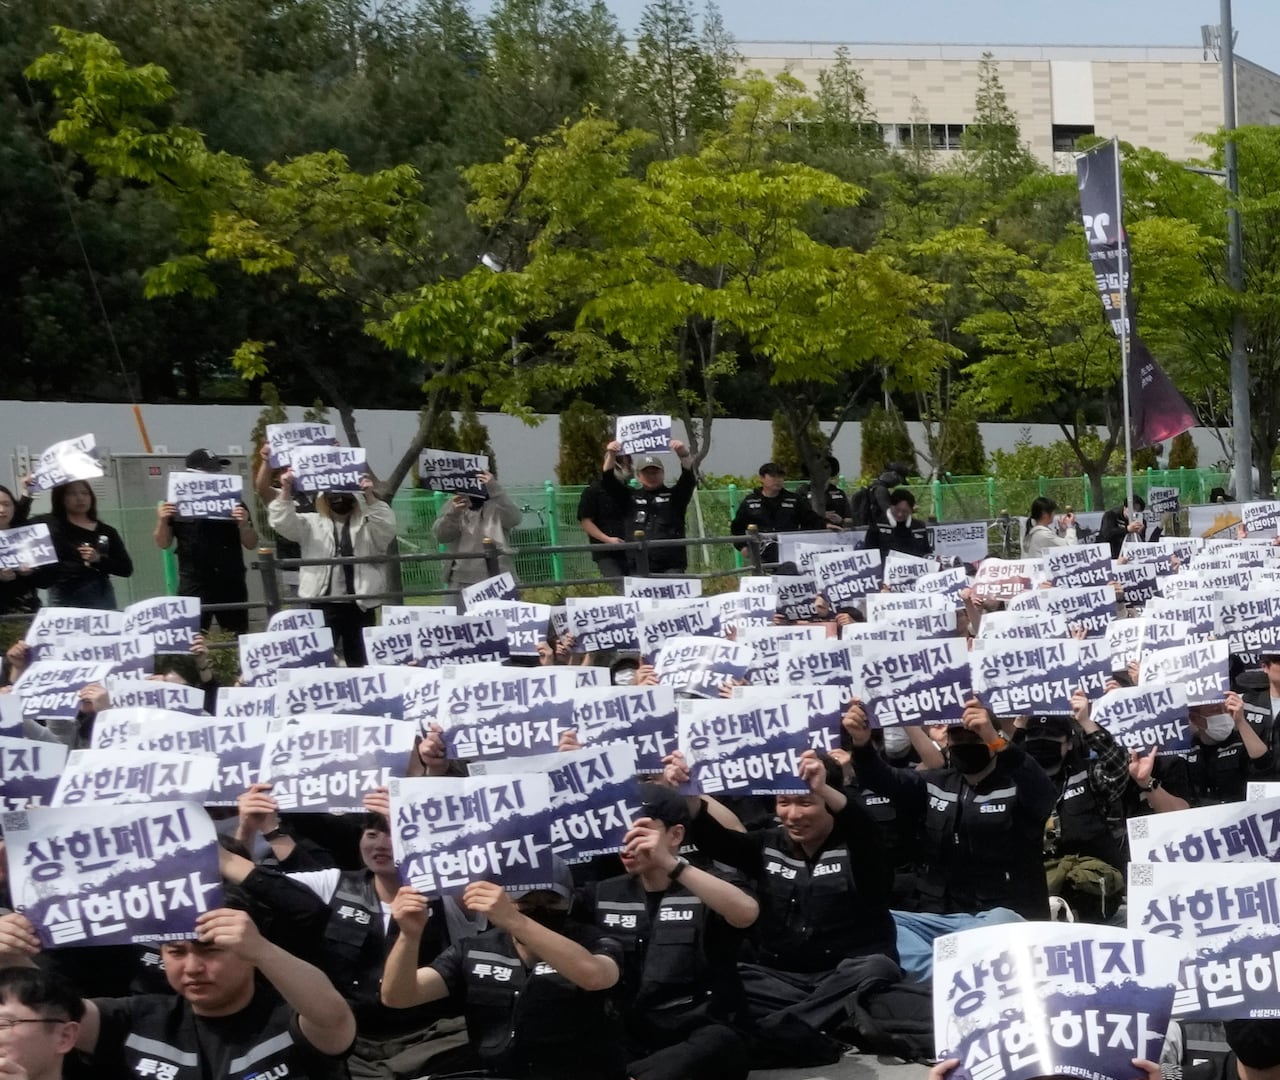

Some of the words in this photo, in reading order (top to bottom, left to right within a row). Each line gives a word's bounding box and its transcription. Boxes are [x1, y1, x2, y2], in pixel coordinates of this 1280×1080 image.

[619, 418, 663, 437] 상한폐지
[623, 436, 670, 454] 실현하자
[296, 450, 354, 470] 상한폐지
[175, 474, 234, 496] 상한폐지
[301, 472, 366, 492] 실현하자
[177, 498, 241, 518] 실현하자
[819, 552, 872, 580] 상한폐지
[827, 578, 882, 601] 실현하자
[245, 635, 328, 671] 상한폐지
[980, 649, 1067, 678] 상한폐지
[861, 653, 954, 688] 상한폐지
[284, 672, 388, 713] 상한폐지
[446, 672, 560, 711] 상한폐지
[989, 685, 1078, 714] 실현하자
[873, 688, 971, 726] 실현하자
[452, 722, 575, 760] 실현하자
[686, 706, 789, 749] 상한폐지
[271, 722, 393, 766] 상한폐지
[698, 753, 801, 793] 실현하자
[270, 767, 392, 810] 실현하자
[398, 780, 525, 838] 상한폐지
[980, 804, 1006, 813] SELU
[24, 806, 194, 880] 상한폐지
[404, 834, 552, 893] 실현하자
[765, 863, 797, 880] 투쟁
[814, 863, 842, 876] SELU
[42, 878, 220, 943] 실현하자
[337, 905, 370, 924] 투쟁
[603, 913, 637, 929] 투쟁
[659, 909, 693, 922] SELU
[131, 934, 182, 943] 삼성전자노동조합
[472, 962, 514, 981] 투쟁
[948, 939, 1146, 1017] 상한폐지
